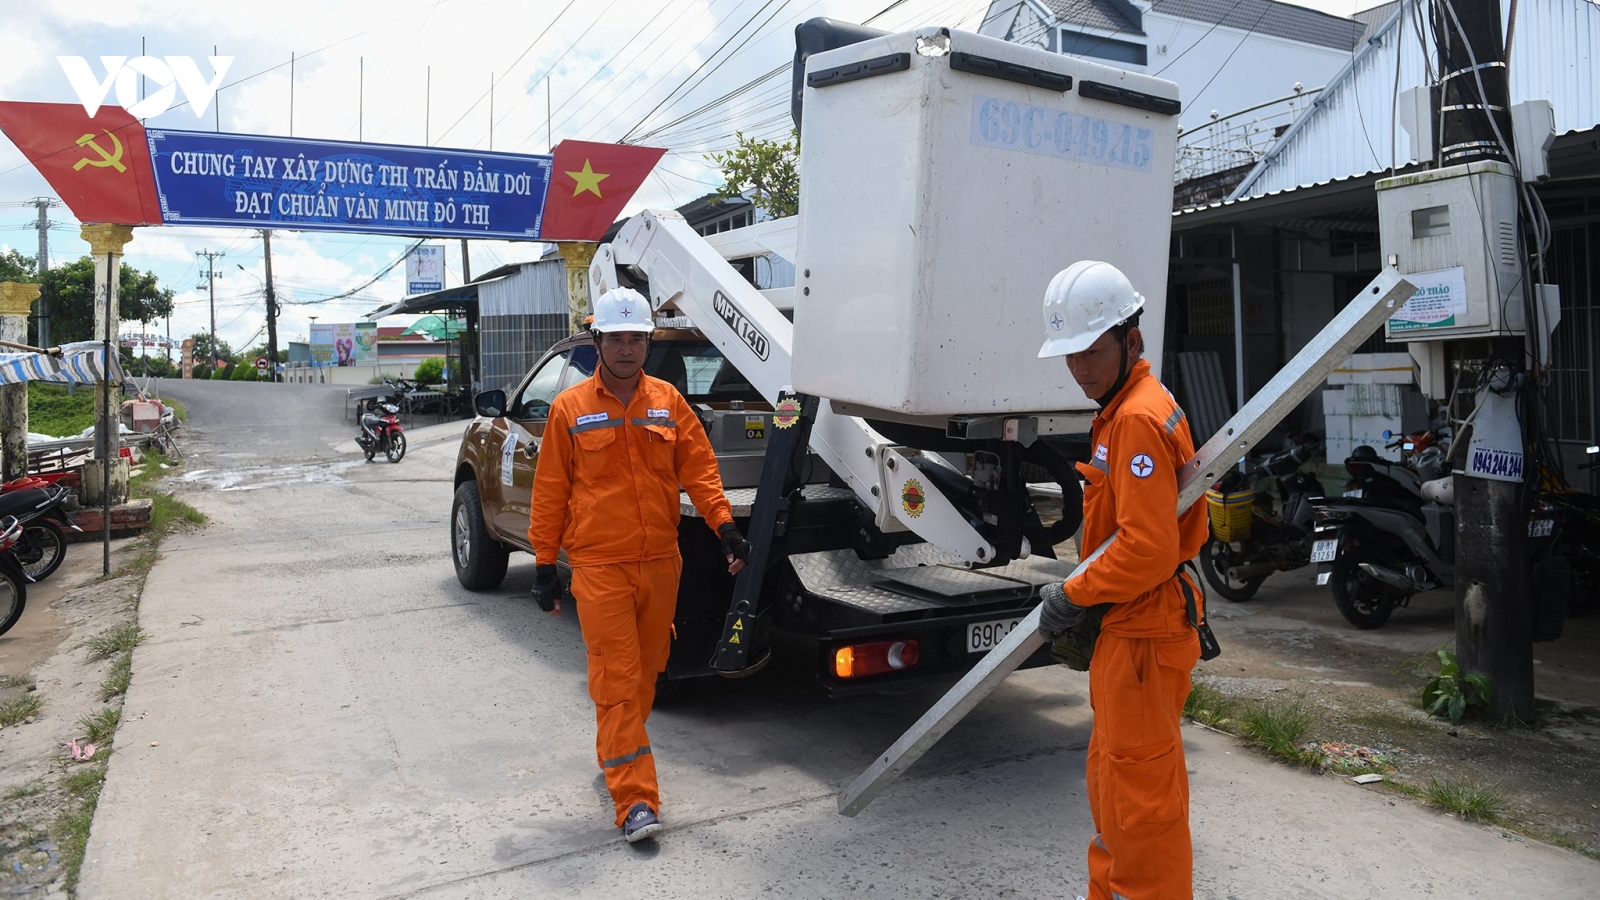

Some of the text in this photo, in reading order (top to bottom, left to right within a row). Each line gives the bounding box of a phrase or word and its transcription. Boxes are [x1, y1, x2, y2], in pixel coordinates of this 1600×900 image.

[979, 98, 1151, 167] 69C-049.15
[171, 151, 531, 195] CHUNG TAY XÂY DỰNG THỊ TRẤN ĐẦM DƠI
[235, 184, 490, 230] ĐẠT CHUẨN VĂN MINH ĐÔ THỊ
[1427, 284, 1450, 296] THẢO
[714, 292, 766, 357] MPT 140
[1473, 451, 1522, 477] 0943.244.244
[1312, 550, 1335, 561] 51261
